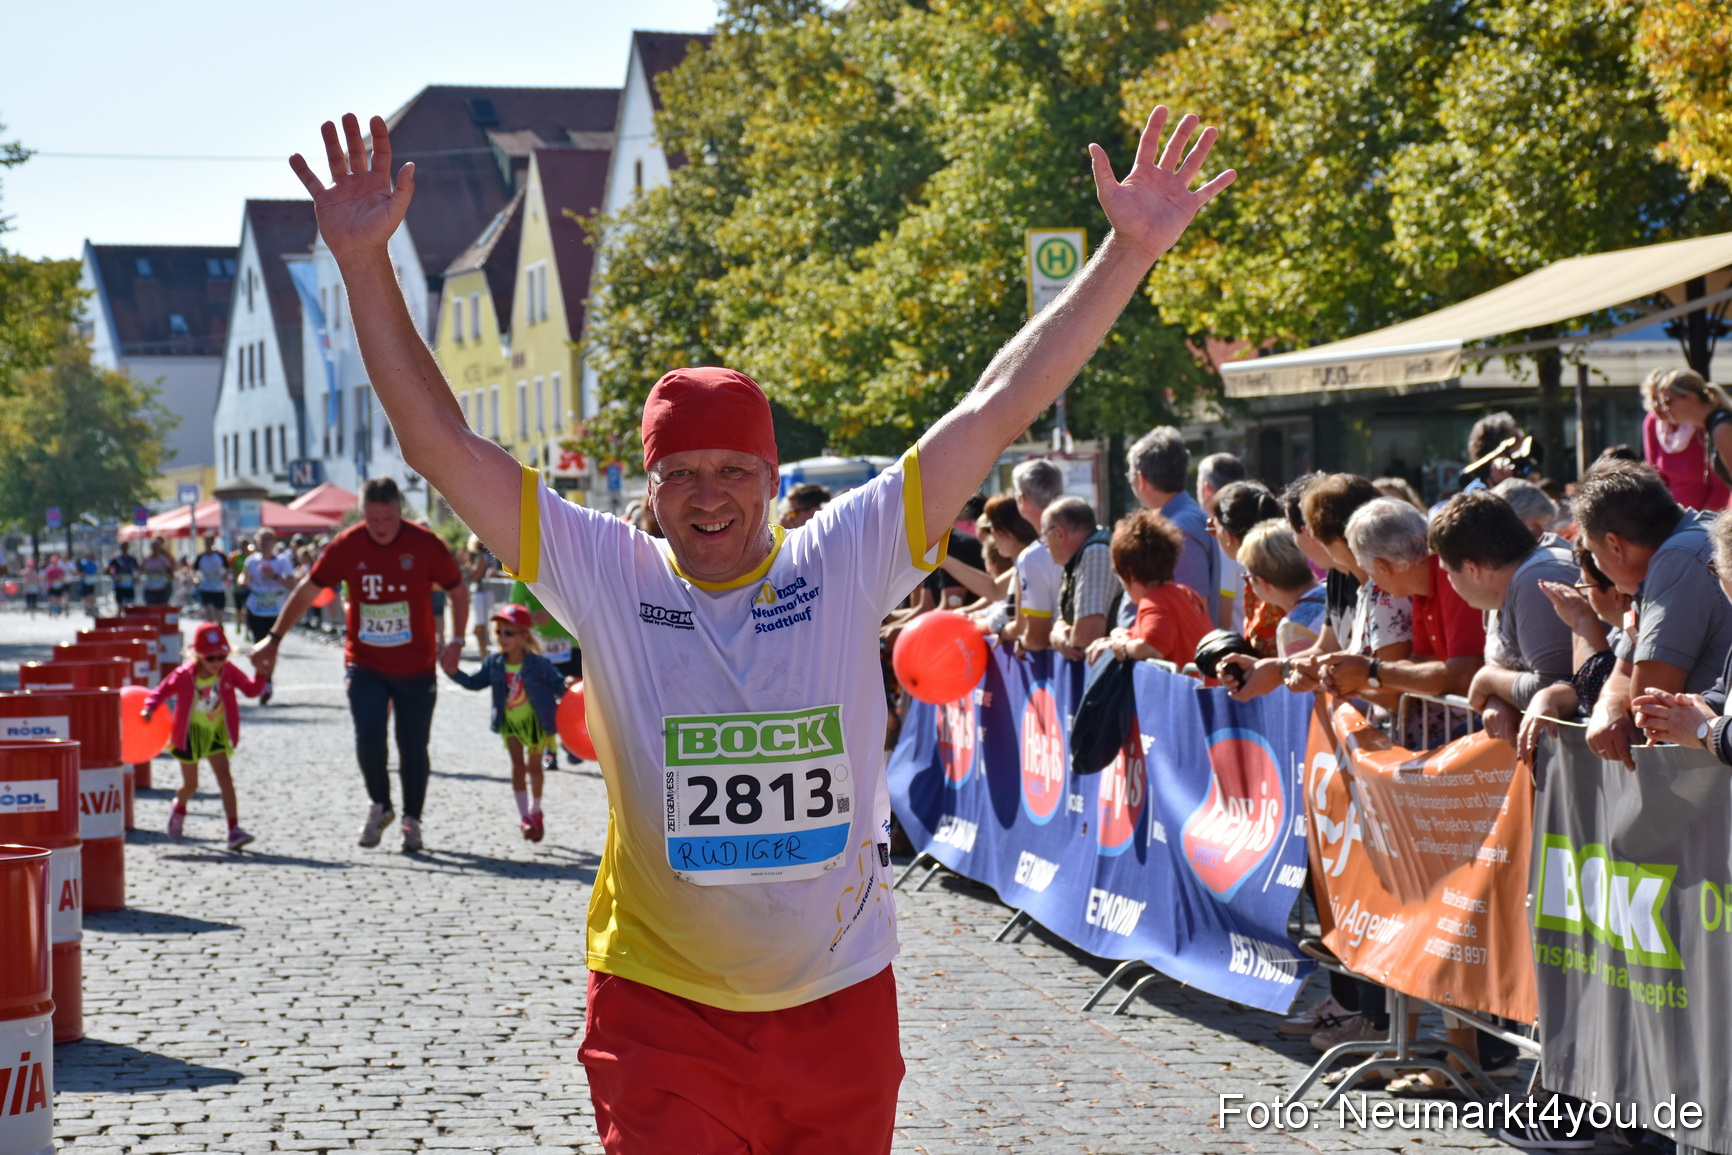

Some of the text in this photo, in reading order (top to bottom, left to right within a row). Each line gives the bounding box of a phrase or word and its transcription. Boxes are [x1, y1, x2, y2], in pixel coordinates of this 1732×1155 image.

[1046, 247, 1067, 270] H
[640, 602, 694, 625] BOCK
[752, 586, 820, 620] Neumarkter
[366, 619, 404, 633] 2473
[754, 605, 812, 634] Stadtlauf
[678, 713, 833, 760] BOCK
[1475, 768, 1514, 784] Partner
[687, 768, 834, 826] 2813
[1462, 791, 1482, 808] und
[1430, 816, 1471, 836] Projekte
[678, 835, 806, 870] RÜDIGER
[1464, 944, 1487, 965] 897
